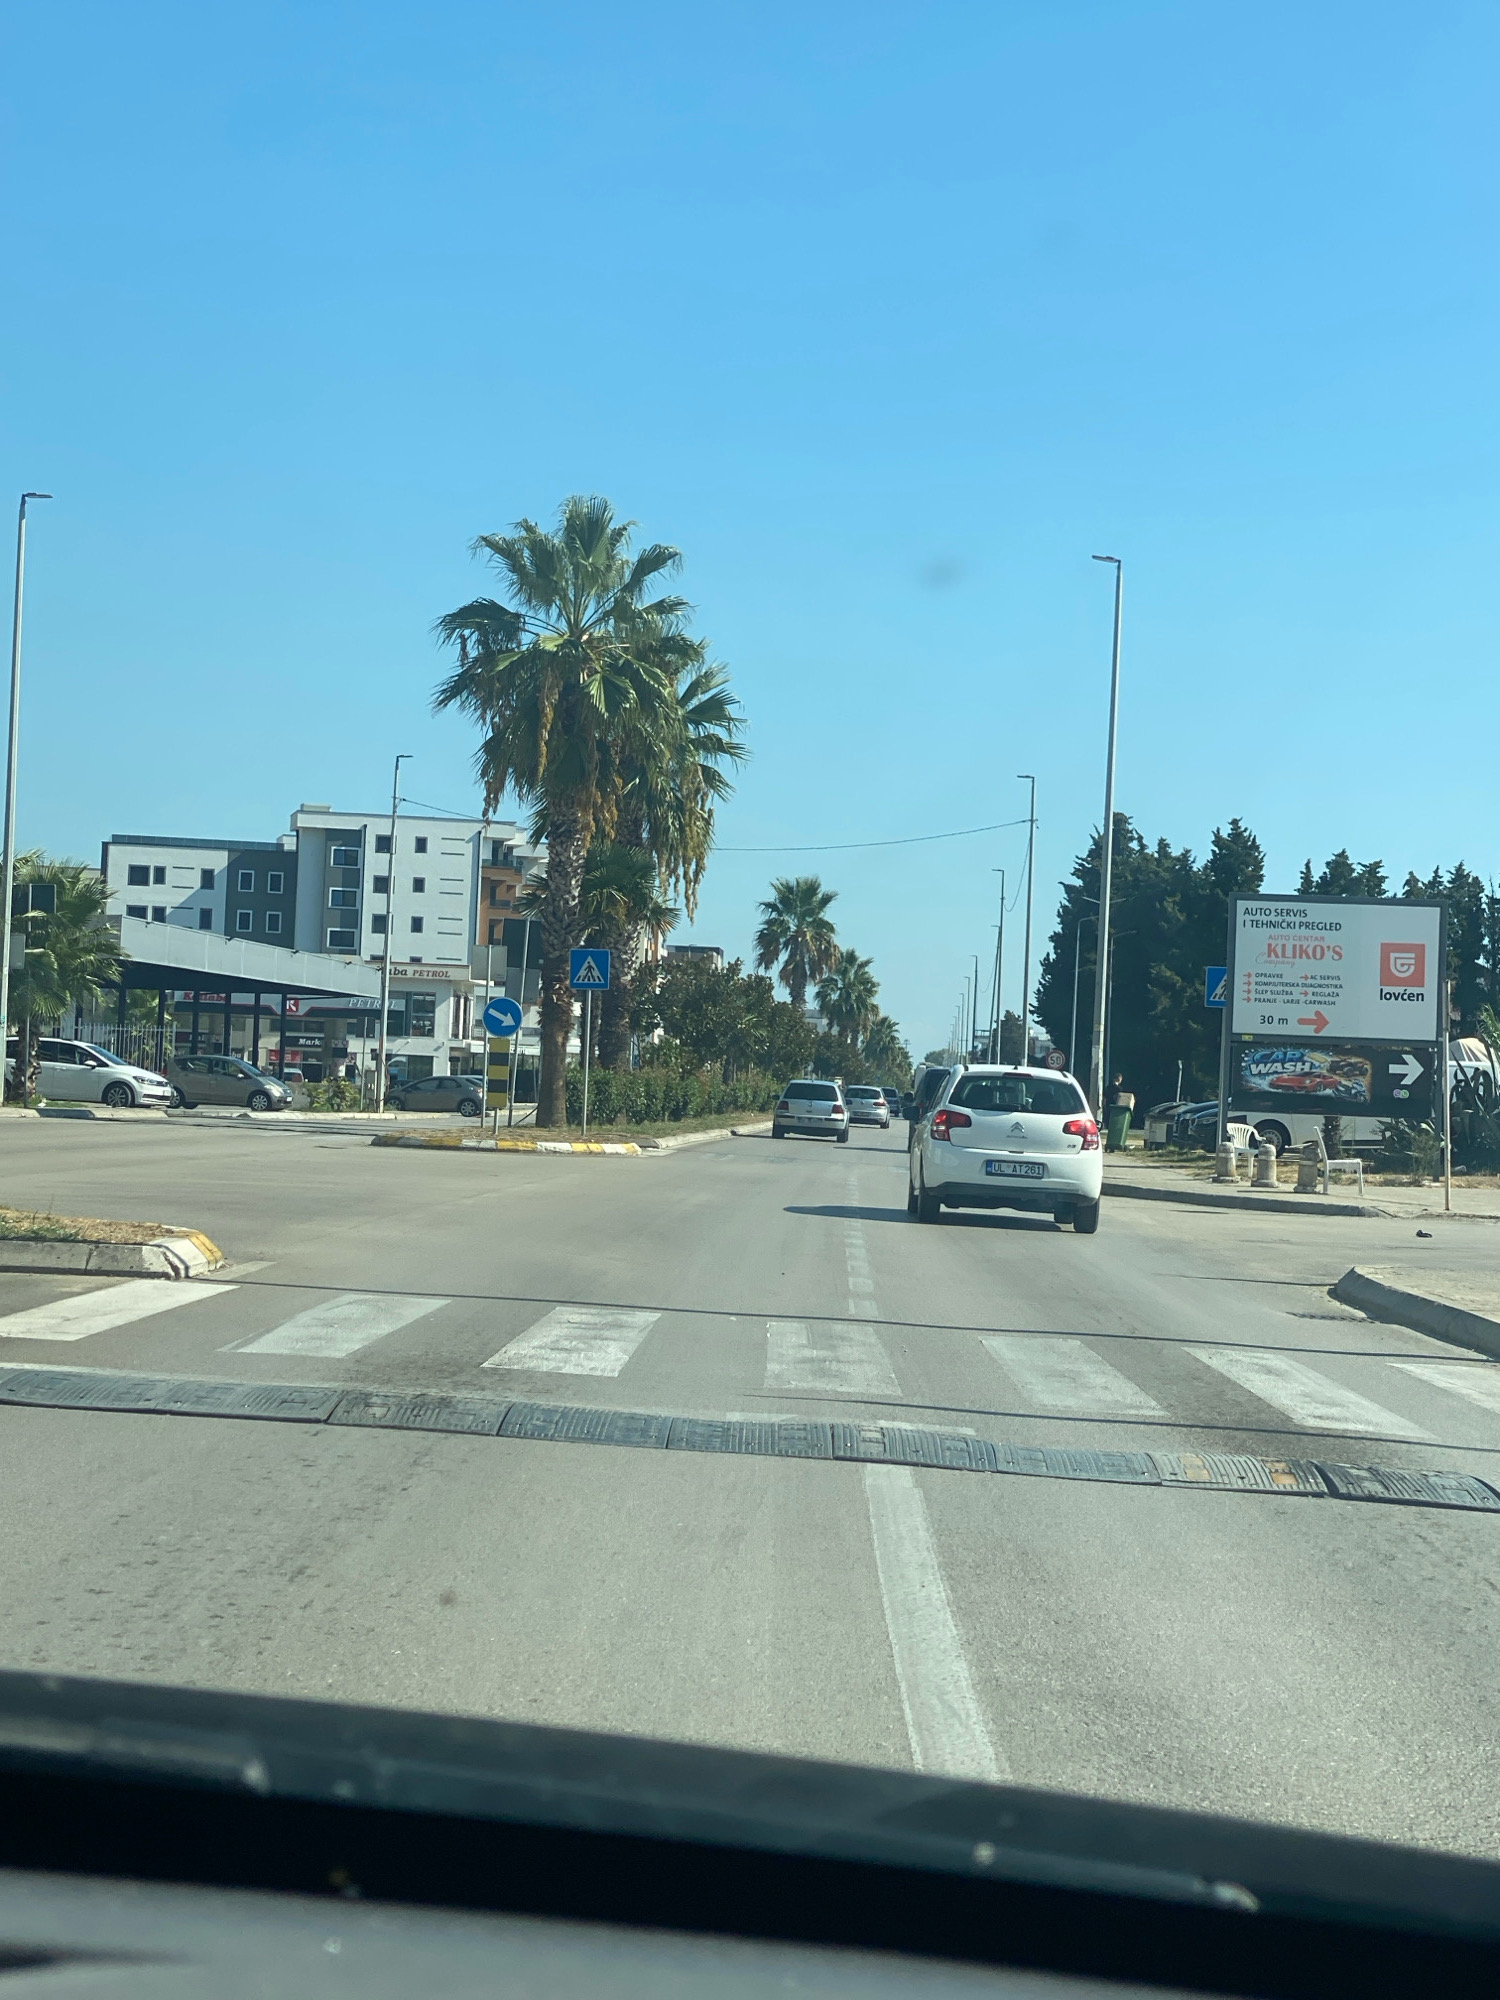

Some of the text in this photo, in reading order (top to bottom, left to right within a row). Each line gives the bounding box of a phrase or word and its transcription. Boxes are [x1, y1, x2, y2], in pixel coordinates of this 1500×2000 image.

[1243, 907, 1308, 918] AUTO SERVIS
[1243, 919, 1342, 931] I TEHNIČKI PREGLED
[1268, 934, 1290, 942] AUTO
[412, 969, 450, 978] PETROL
[1311, 990, 1340, 998] REGLAŽA
[1380, 988, 1424, 1002] lovćen
[1259, 1015, 1288, 1025] 30 m
[1050, 1055, 1062, 1065] 50
[1254, 1050, 1305, 1063] CAR
[1251, 1062, 1313, 1075] WASH
[993, 1163, 1006, 1173] UL
[1012, 1164, 1042, 1176] AT261
